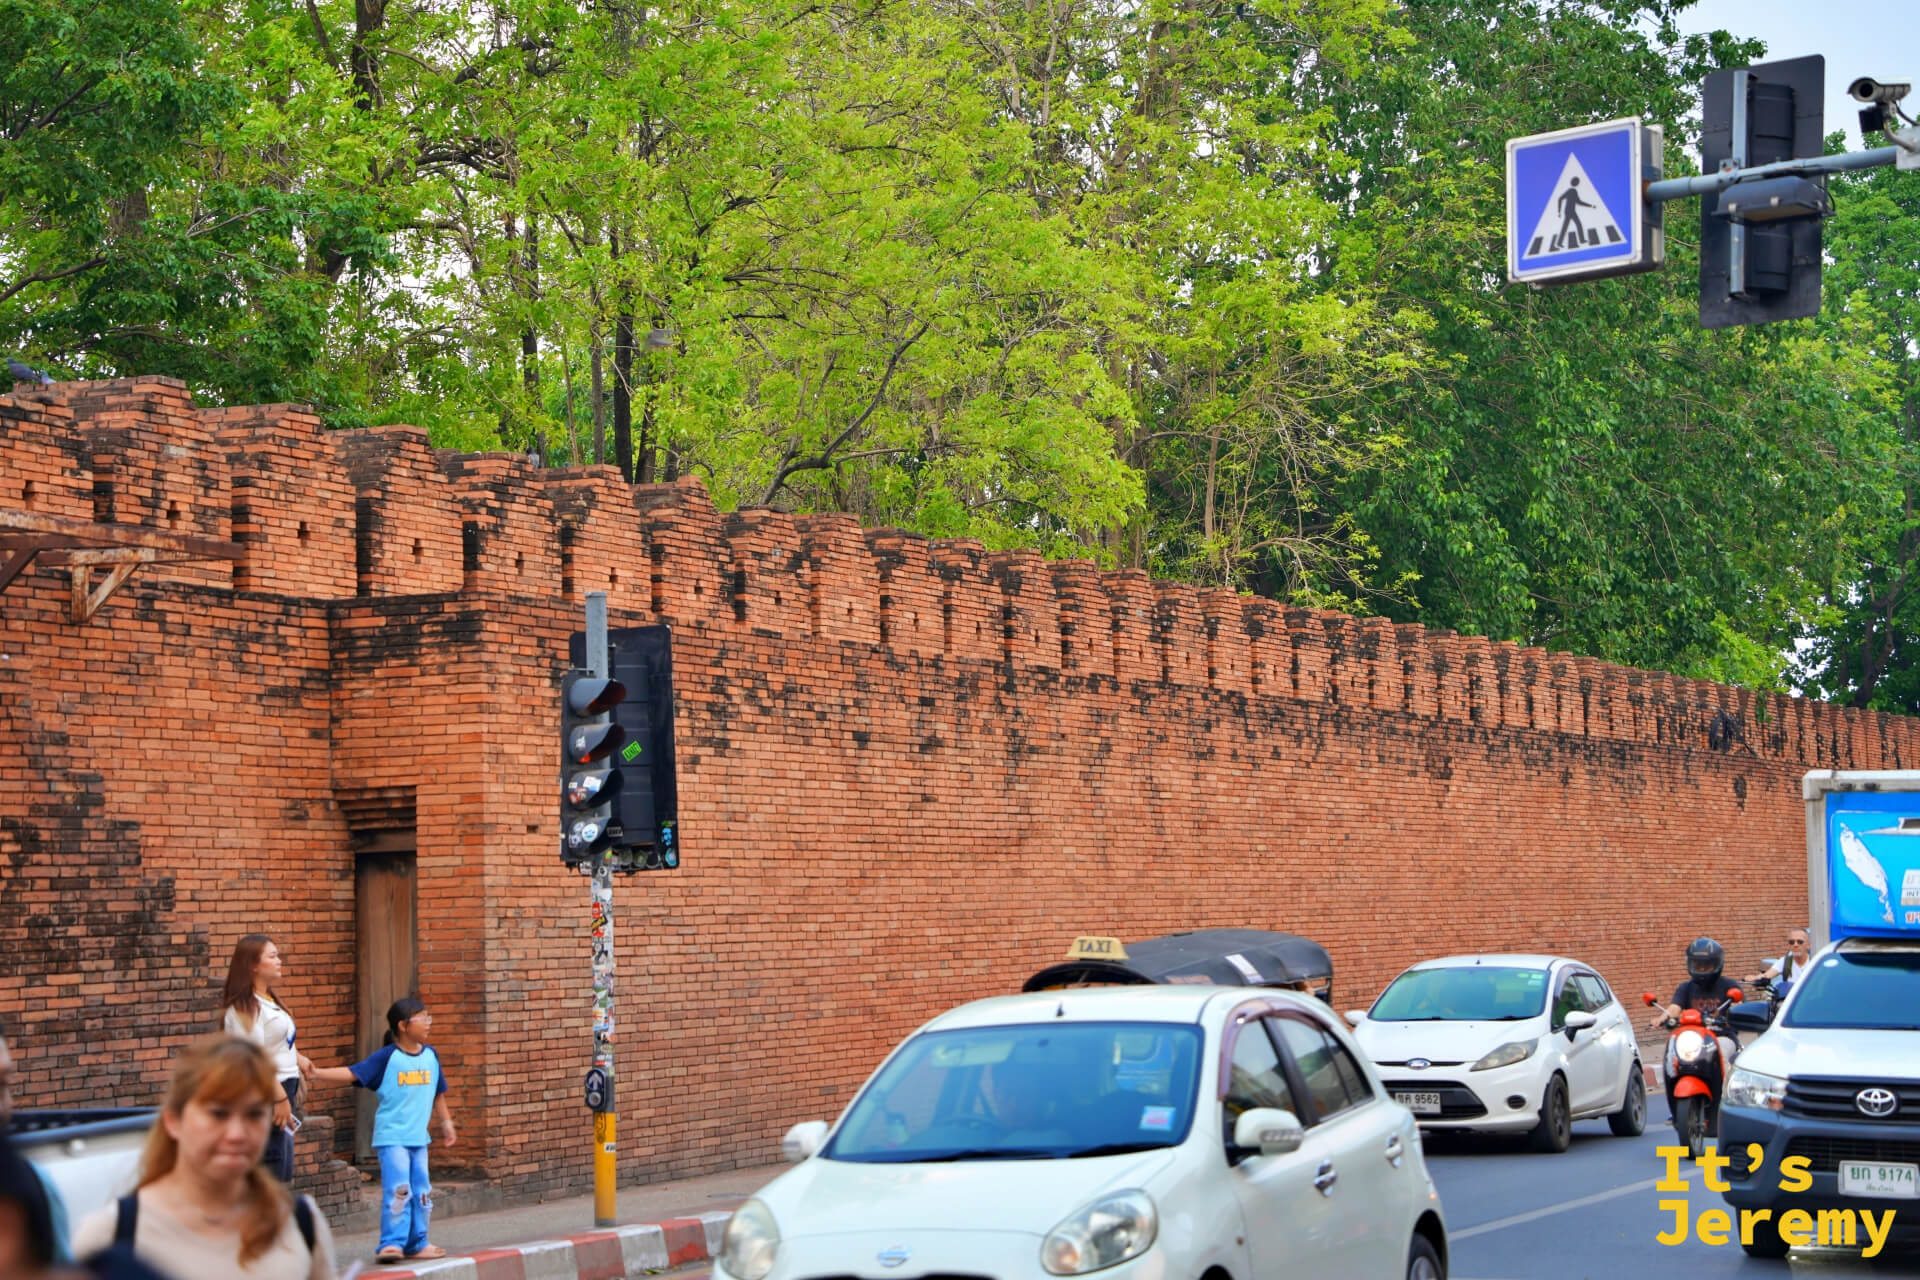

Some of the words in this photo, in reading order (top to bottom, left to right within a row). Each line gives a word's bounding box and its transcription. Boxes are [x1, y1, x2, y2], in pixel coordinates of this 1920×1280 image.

[1078, 939, 1112, 953] TAXI
[1415, 1094, 1439, 1104] 9562
[1878, 1167, 1912, 1182] 9174
